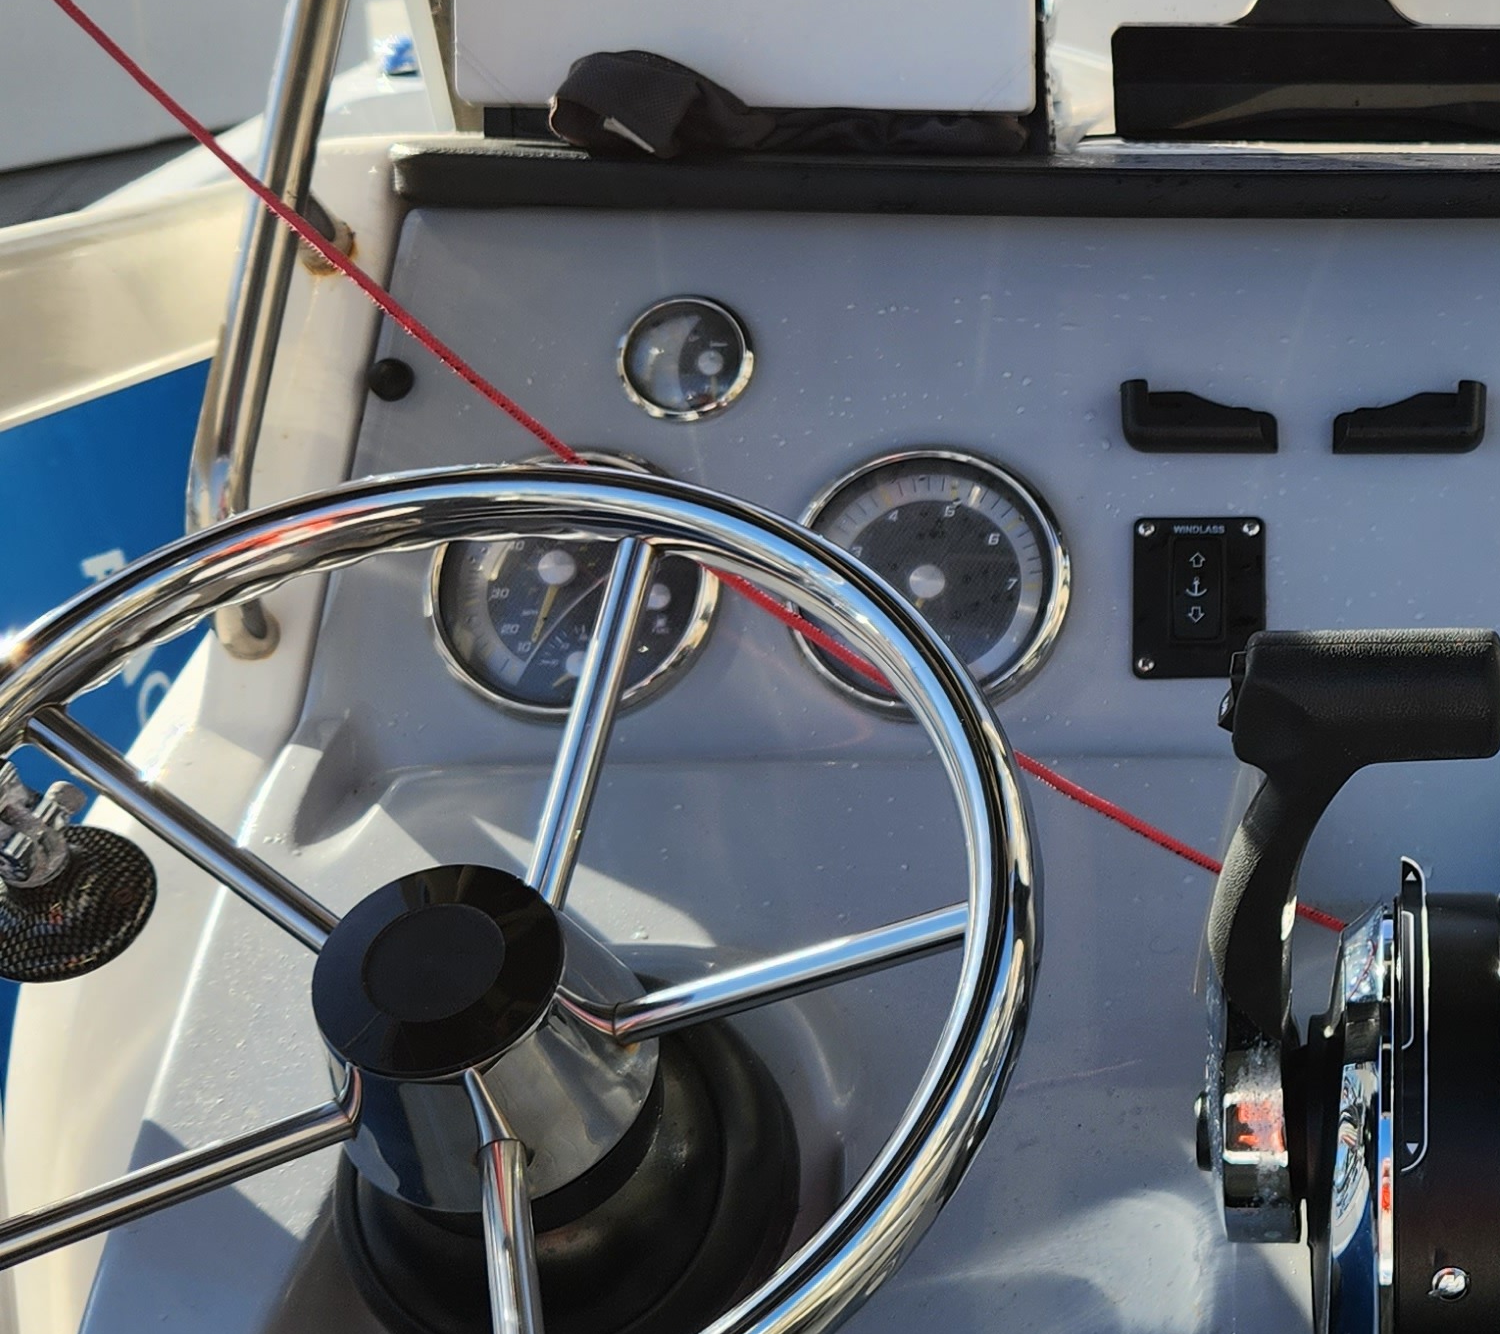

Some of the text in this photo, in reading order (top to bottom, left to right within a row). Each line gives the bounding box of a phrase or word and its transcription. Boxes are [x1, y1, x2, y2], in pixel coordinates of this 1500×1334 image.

[1173, 525, 1225, 535] WINDLASS
[988, 533, 1000, 545] 6
[1007, 578, 1018, 591] 7
[491, 588, 510, 600] 30
[501, 623, 520, 635] 20
[517, 642, 532, 653] 10
